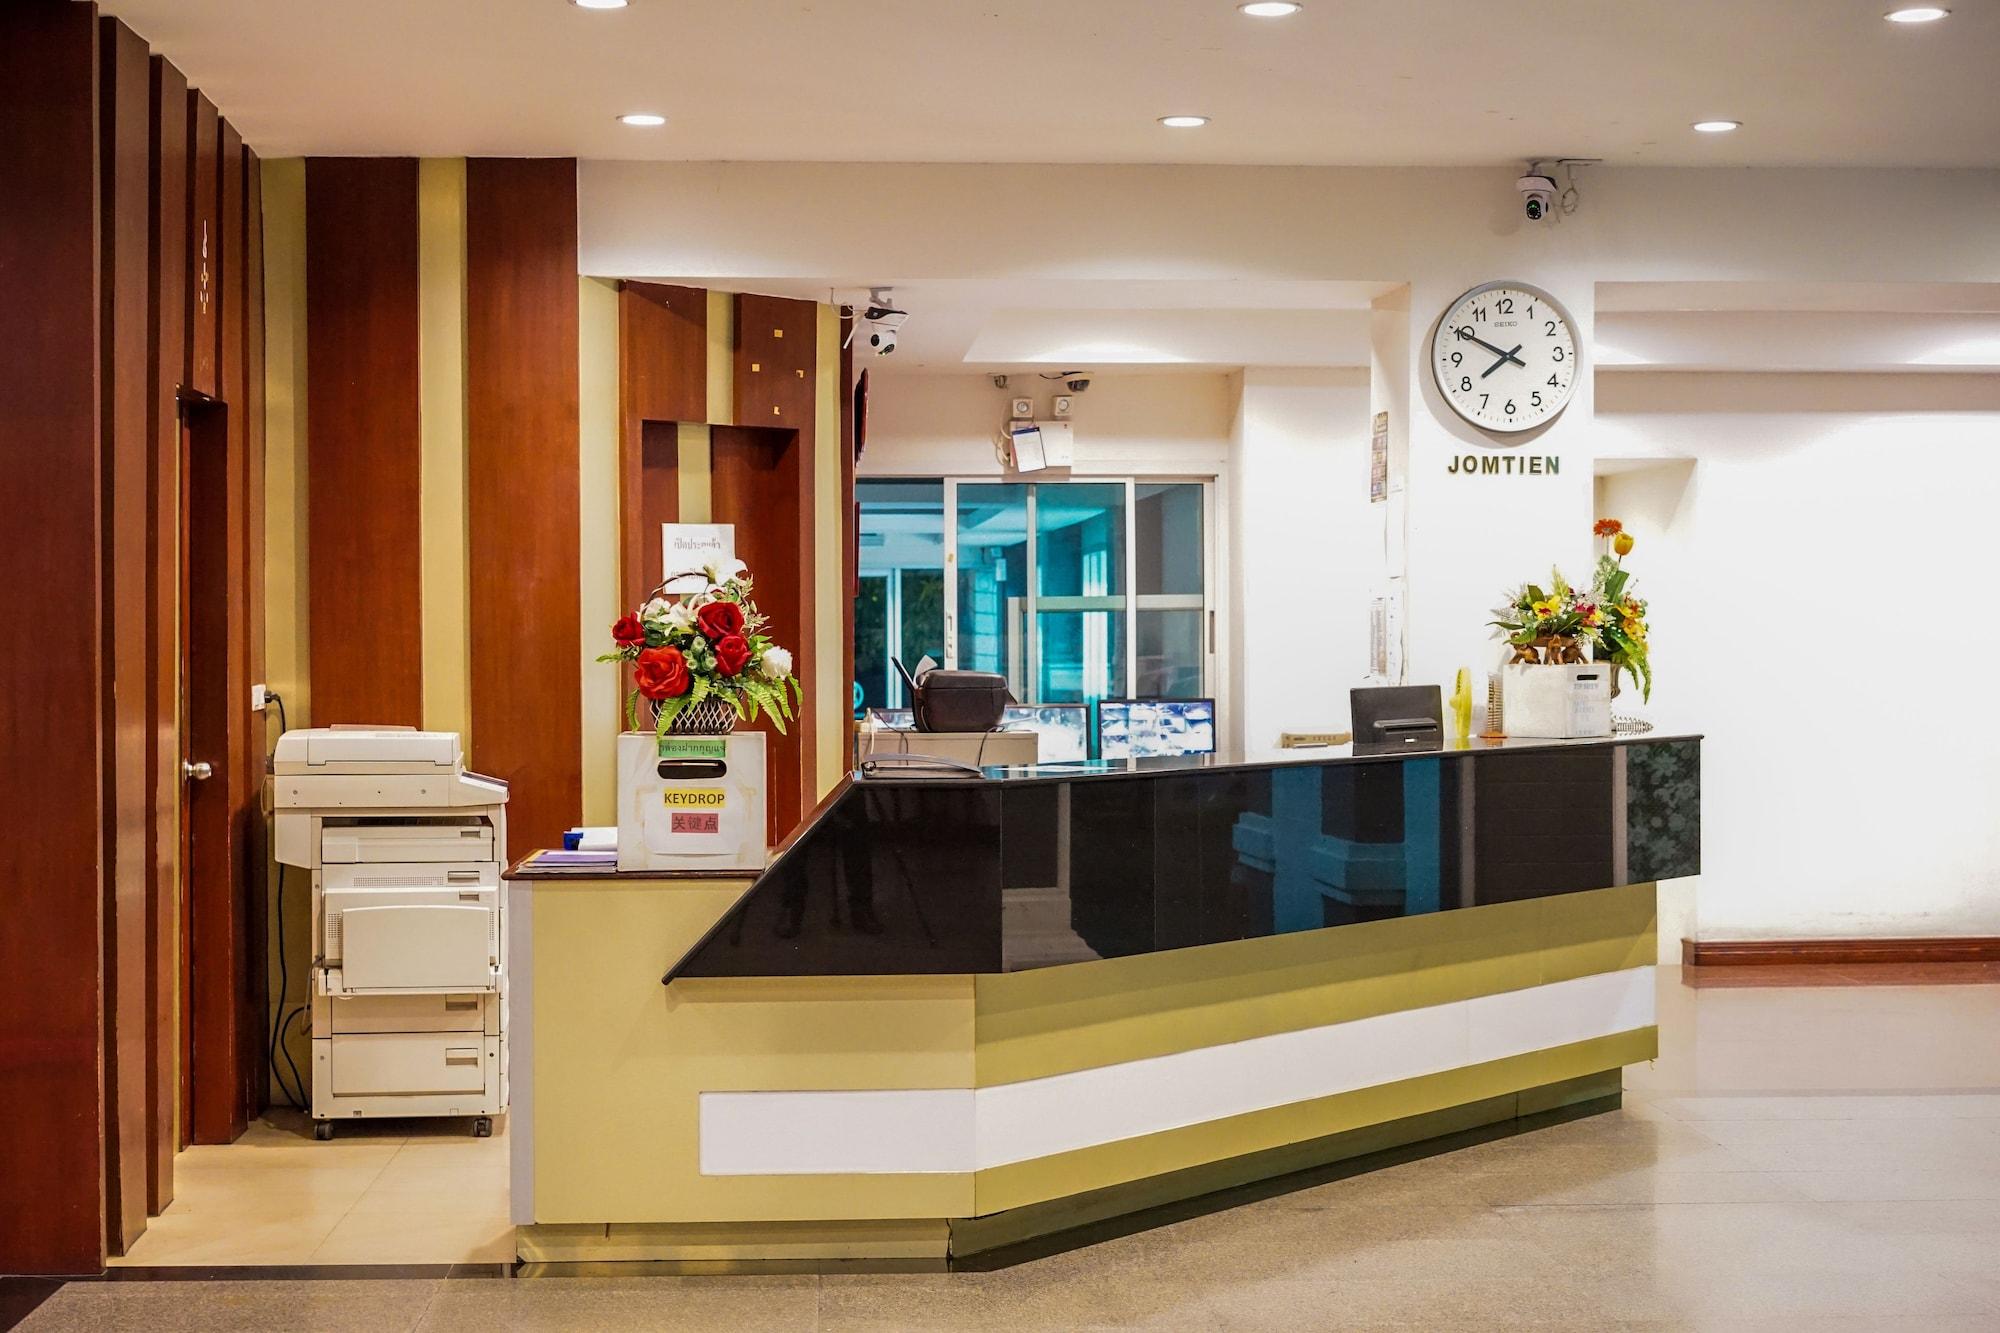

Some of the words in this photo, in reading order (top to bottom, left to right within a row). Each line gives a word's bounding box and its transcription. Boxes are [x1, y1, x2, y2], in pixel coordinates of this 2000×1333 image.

[1472, 307, 1486, 322] 11
[1495, 299, 1514, 315] 12
[1526, 305, 1534, 319] 1
[1454, 326, 1475, 341] 10
[1545, 321, 1556, 336] 2
[1451, 352, 1463, 368] 9
[1553, 347, 1564, 362] 3
[1461, 376, 1472, 392] 8
[1547, 373, 1559, 388] 4
[1480, 394, 1490, 409] 7
[1531, 391, 1542, 407] 5
[1504, 399, 1516, 415] 6
[1448, 456, 1560, 475] JOMTIEN
[664, 793, 725, 804] KEYDROP
[673, 816, 717, 830] 关键点
